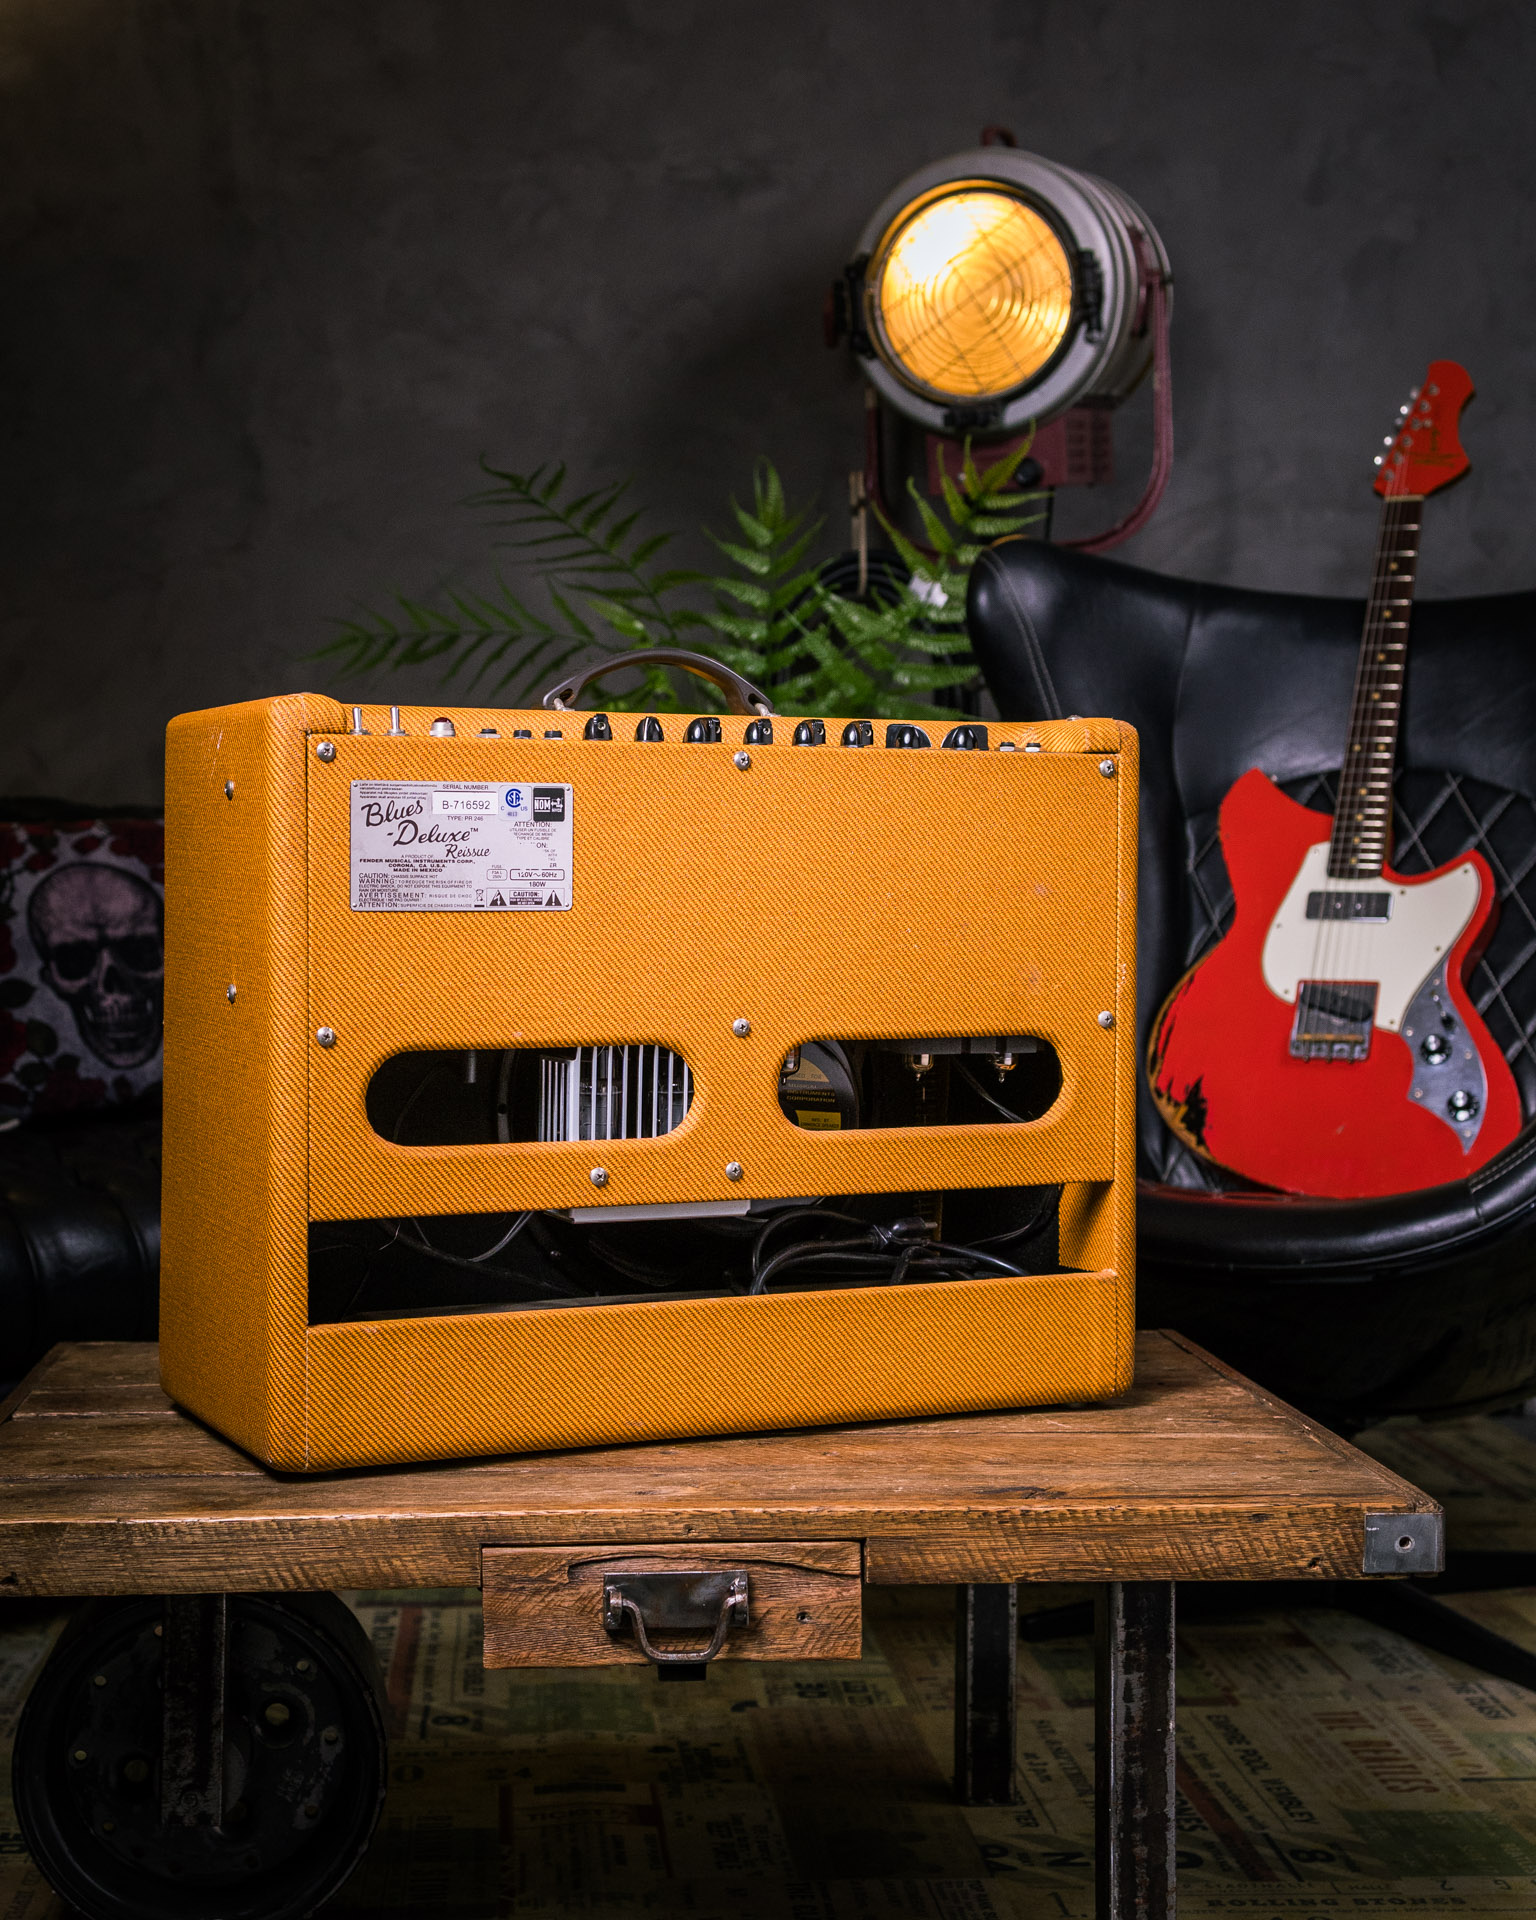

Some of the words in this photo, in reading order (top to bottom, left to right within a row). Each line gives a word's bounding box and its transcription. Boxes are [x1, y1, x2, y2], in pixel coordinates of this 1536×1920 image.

[442, 800, 490, 810] B-716592
[534, 800, 550, 810] NOM
[361, 800, 423, 827] Blues
[445, 844, 490, 859] Reissue
